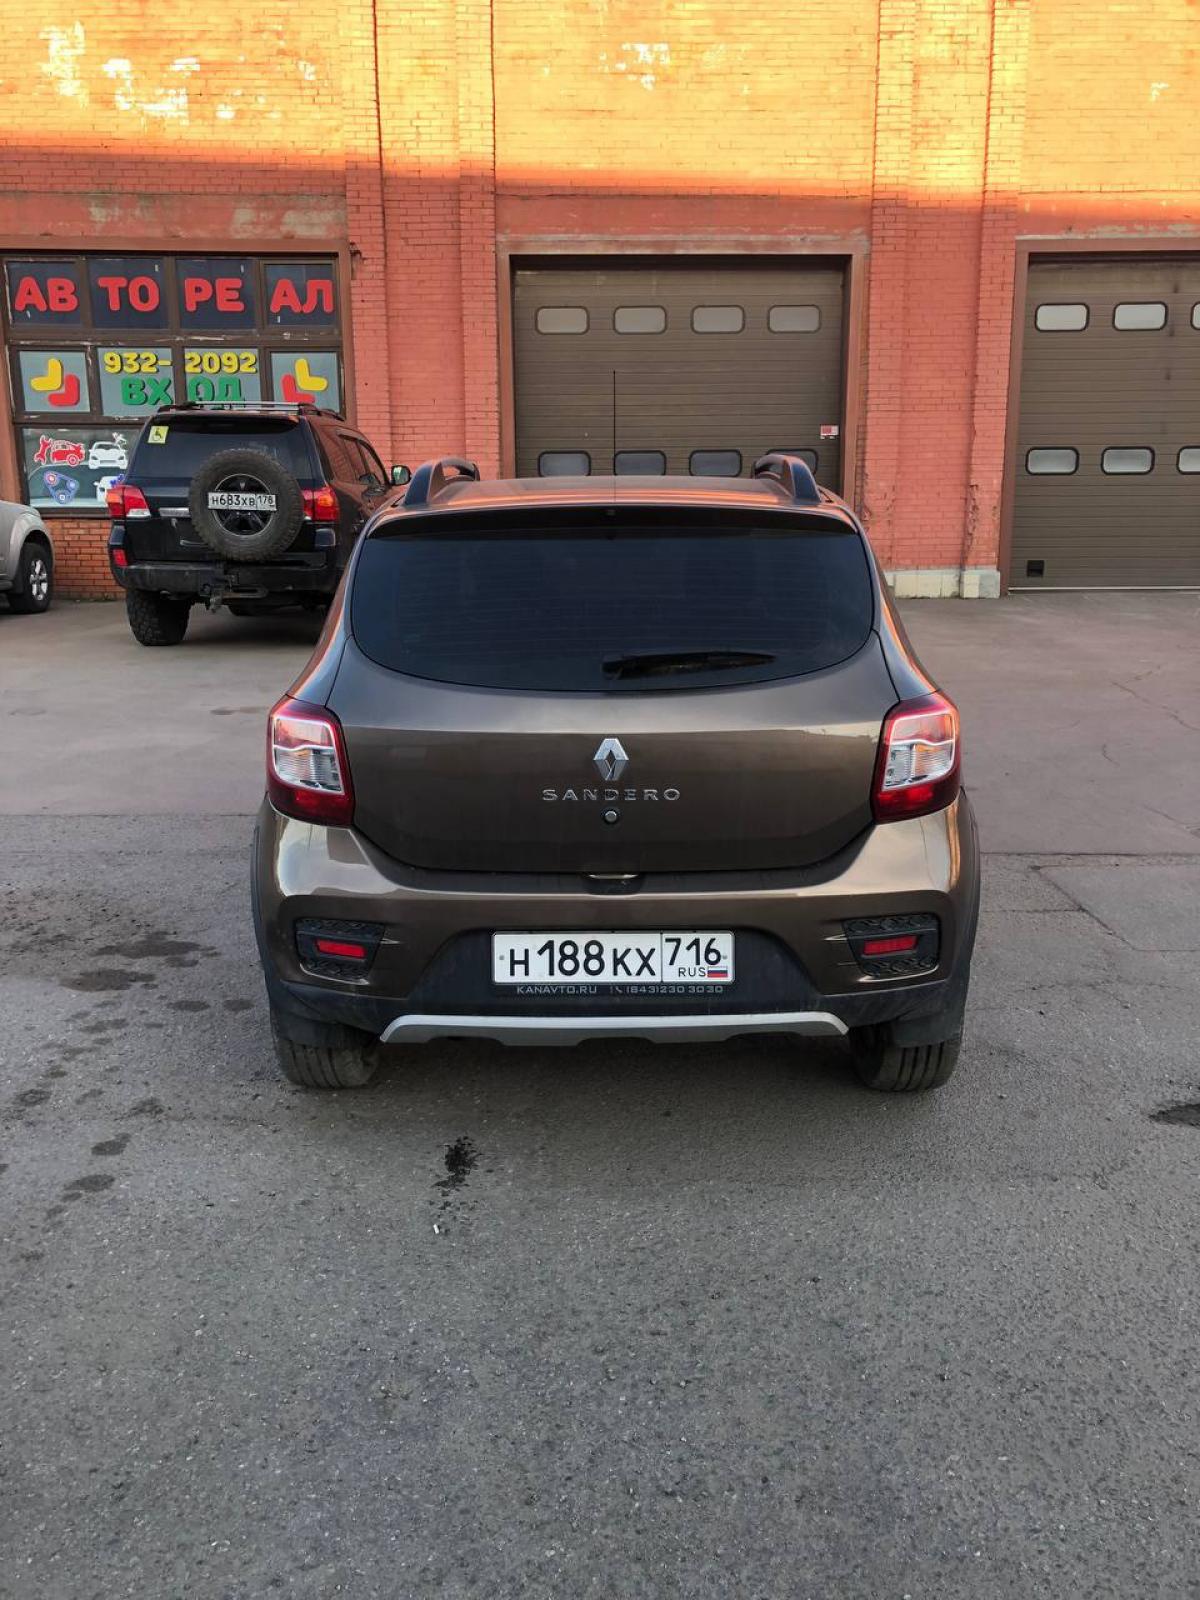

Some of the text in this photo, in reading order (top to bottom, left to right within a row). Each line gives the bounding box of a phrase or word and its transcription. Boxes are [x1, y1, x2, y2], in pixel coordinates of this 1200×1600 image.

[542, 788, 681, 801] SANDERO
[664, 937, 722, 966] 716
[678, 967, 706, 978] RUS
[516, 985, 598, 995] KANAVTO.RU
